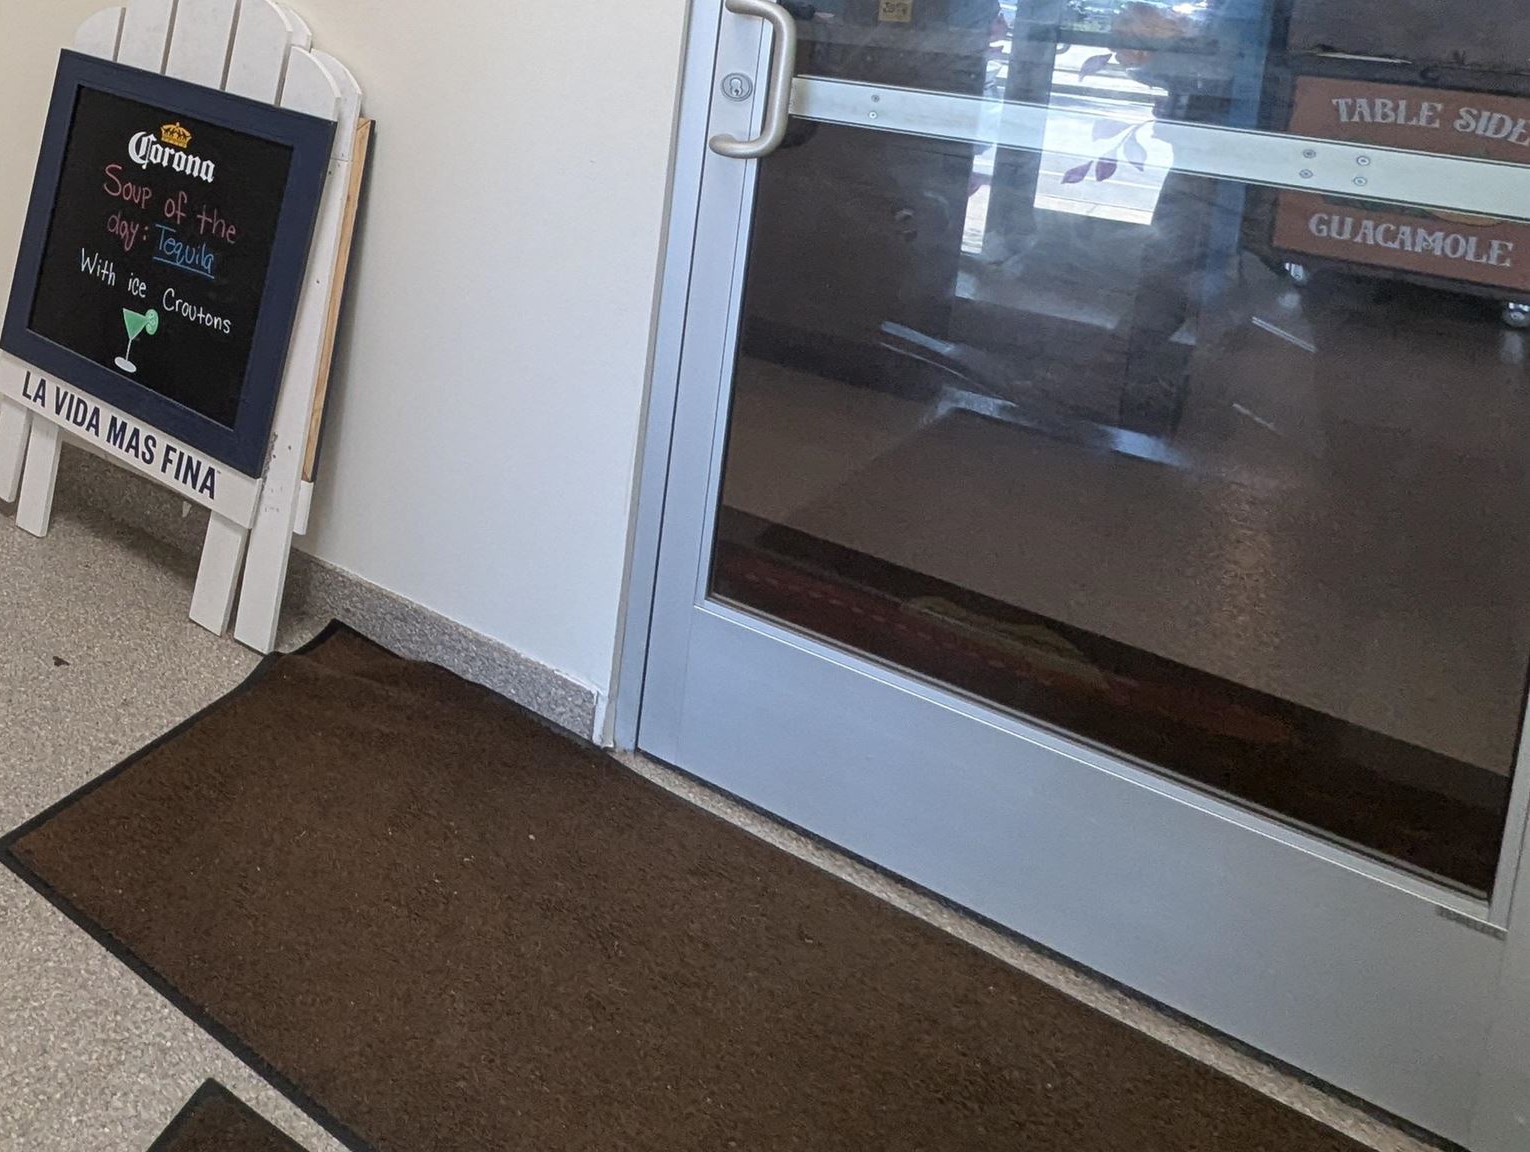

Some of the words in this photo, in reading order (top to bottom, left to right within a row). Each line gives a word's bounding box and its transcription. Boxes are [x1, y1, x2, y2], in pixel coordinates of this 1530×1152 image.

[1332, 98, 1444, 129] TABLE
[1453, 107, 1530, 147] SIDE
[128, 131, 216, 183] Corona
[104, 164, 152, 209] Soup
[164, 191, 188, 224] of
[197, 204, 237, 244] the
[155, 223, 215, 274] Tequila
[1309, 213, 1513, 267] GUACAMOLE
[81, 247, 116, 286] With
[127, 272, 147, 298] ice
[162, 287, 232, 334] Croutons
[21, 371, 47, 408] LA
[53, 385, 101, 437] VIDA
[105, 414, 157, 465] MAS
[160, 443, 216, 500] FINA
